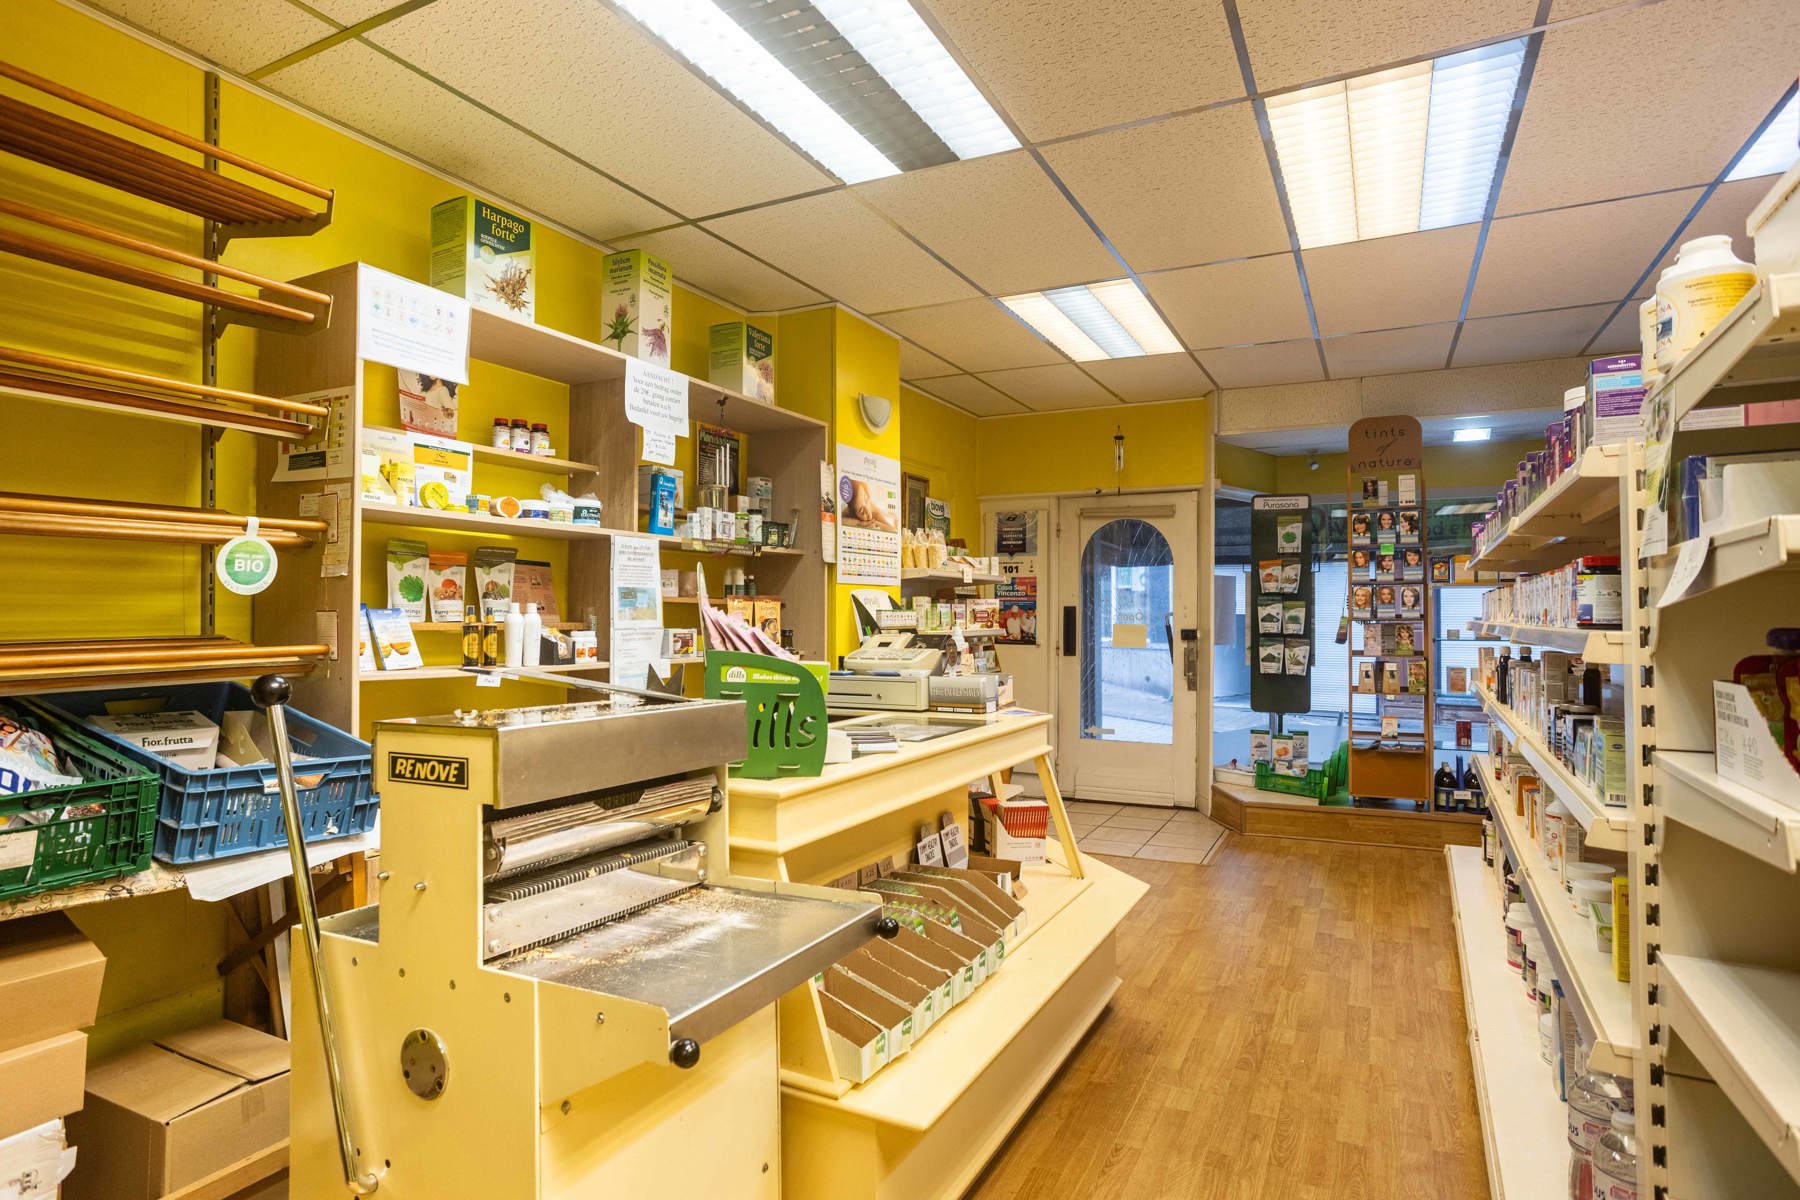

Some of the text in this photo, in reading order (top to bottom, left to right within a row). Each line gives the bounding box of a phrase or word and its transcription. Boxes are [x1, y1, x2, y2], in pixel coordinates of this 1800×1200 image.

[482, 206, 525, 234] Harpago
[491, 223, 516, 243] forte
[1364, 427, 1406, 439] tints
[233, 558, 264, 573] BIO
[1003, 565, 1020, 574] 101
[728, 669, 745, 680] dills
[752, 700, 818, 750] ills
[395, 758, 460, 783] RENOVE
